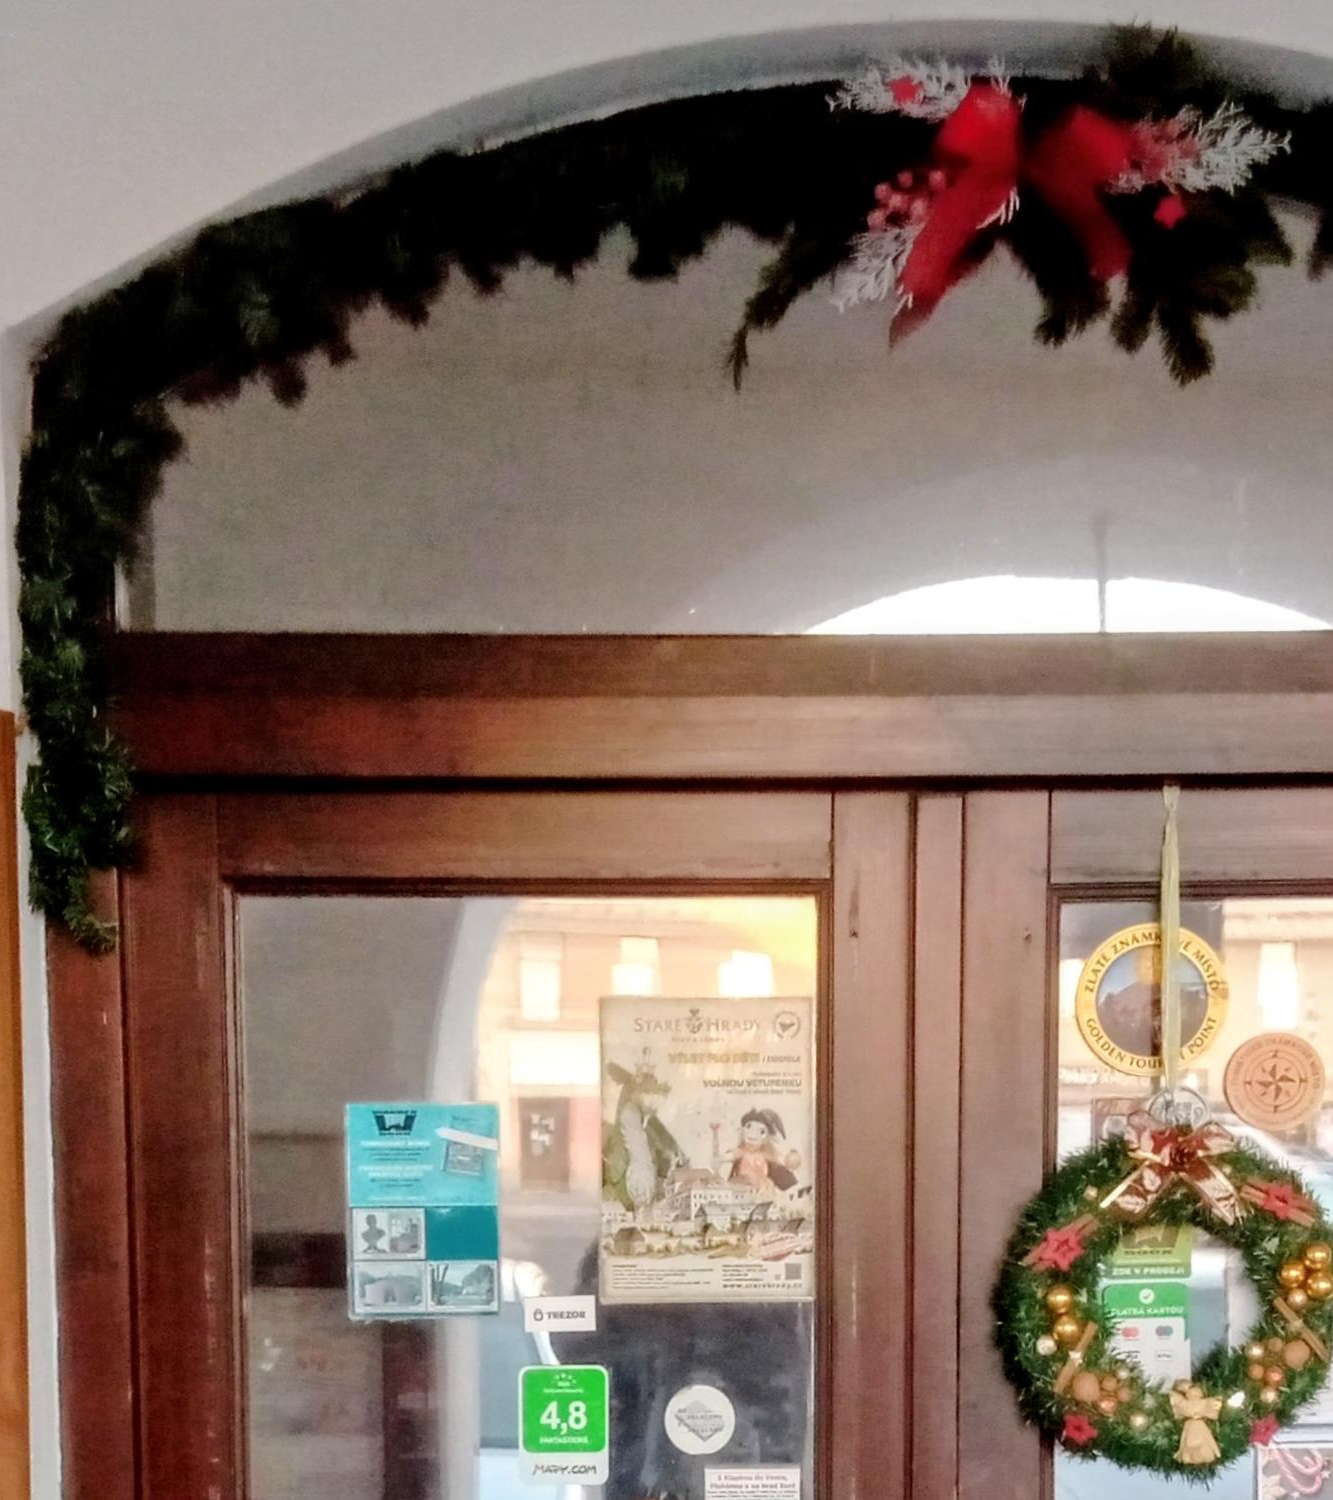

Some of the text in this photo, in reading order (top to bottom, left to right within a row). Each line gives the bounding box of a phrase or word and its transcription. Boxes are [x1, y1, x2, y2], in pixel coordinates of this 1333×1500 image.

[1113, 931, 1191, 953] ZNÁMKÉ
[1086, 1017, 1126, 1066] GOLDEN
[1186, 1017, 1217, 1055] POINT
[546, 1311, 585, 1320] TREZOR
[539, 1400, 587, 1434] 4,8
[533, 1464, 597, 1475] MAPY.COM
